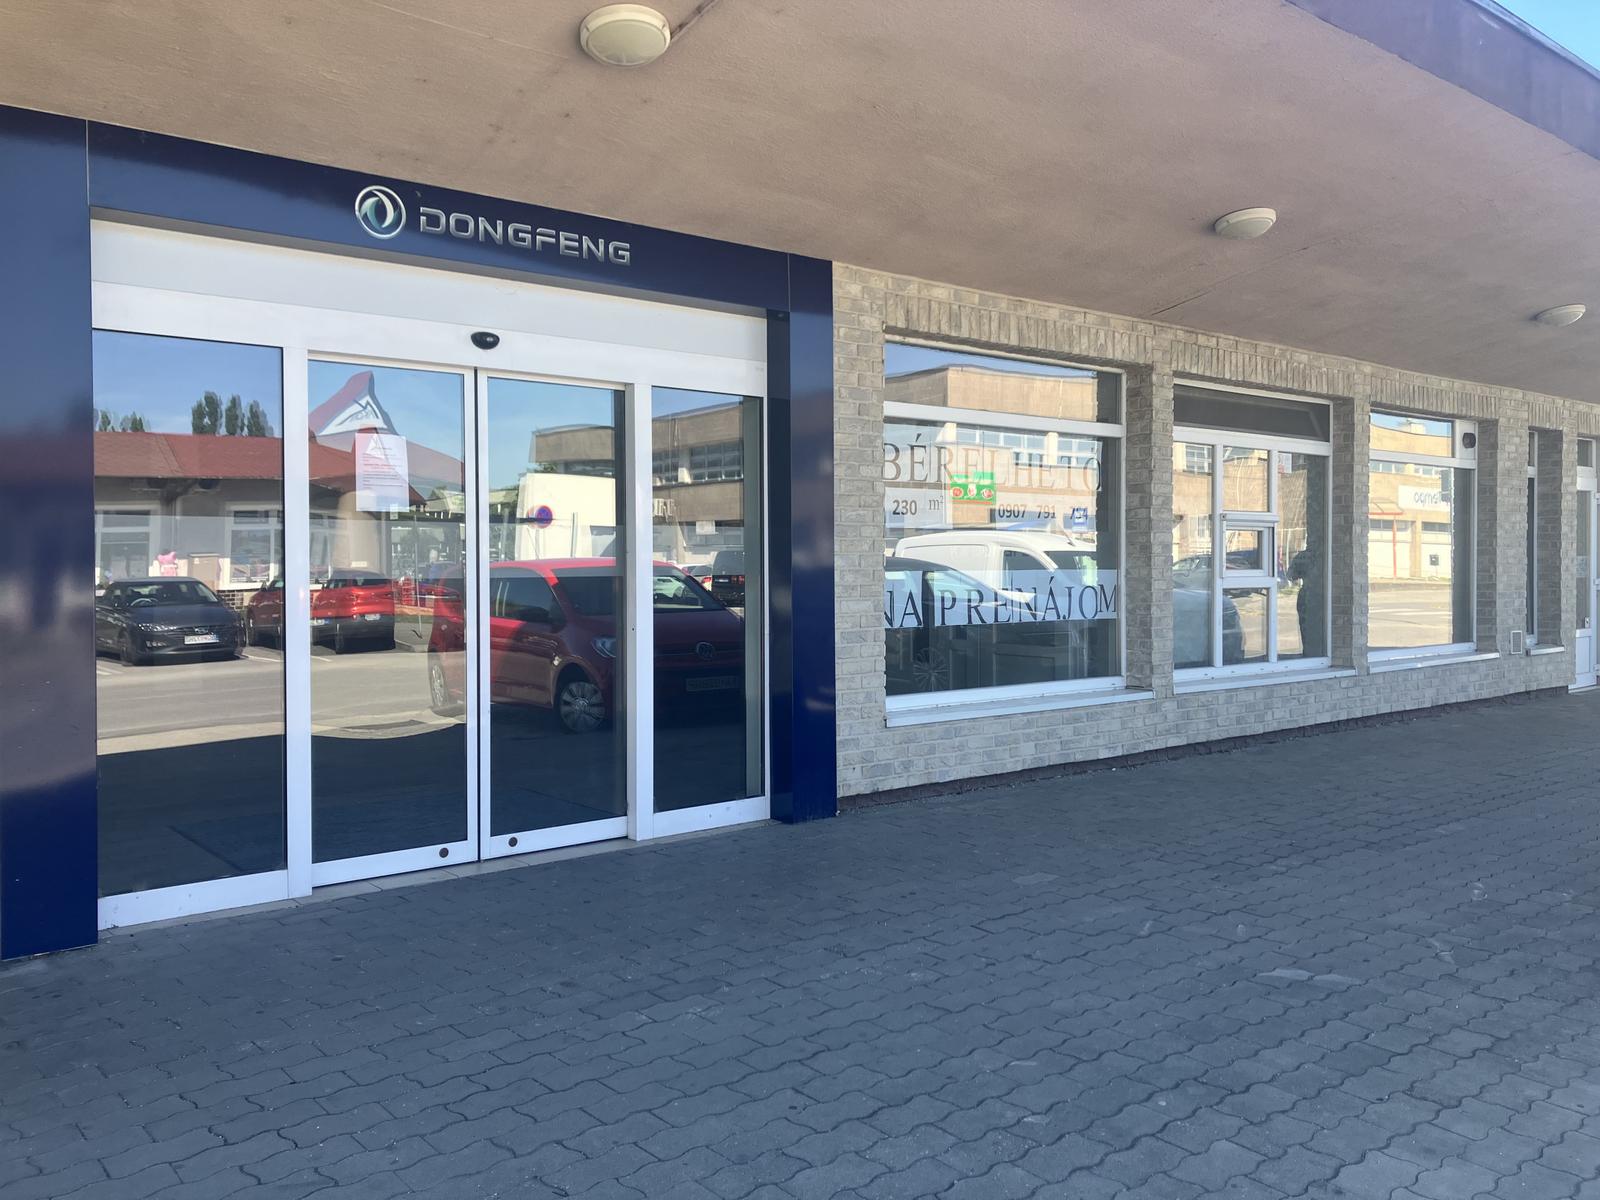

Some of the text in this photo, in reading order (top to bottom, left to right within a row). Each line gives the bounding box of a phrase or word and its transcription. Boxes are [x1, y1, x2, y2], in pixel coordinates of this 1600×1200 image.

[420, 206, 631, 266] DONGFENG
[892, 499, 918, 516] 230
[998, 503, 1026, 519] 0907
[1036, 504, 1056, 520] 791
[938, 576, 1116, 626] PRENÁJOM
